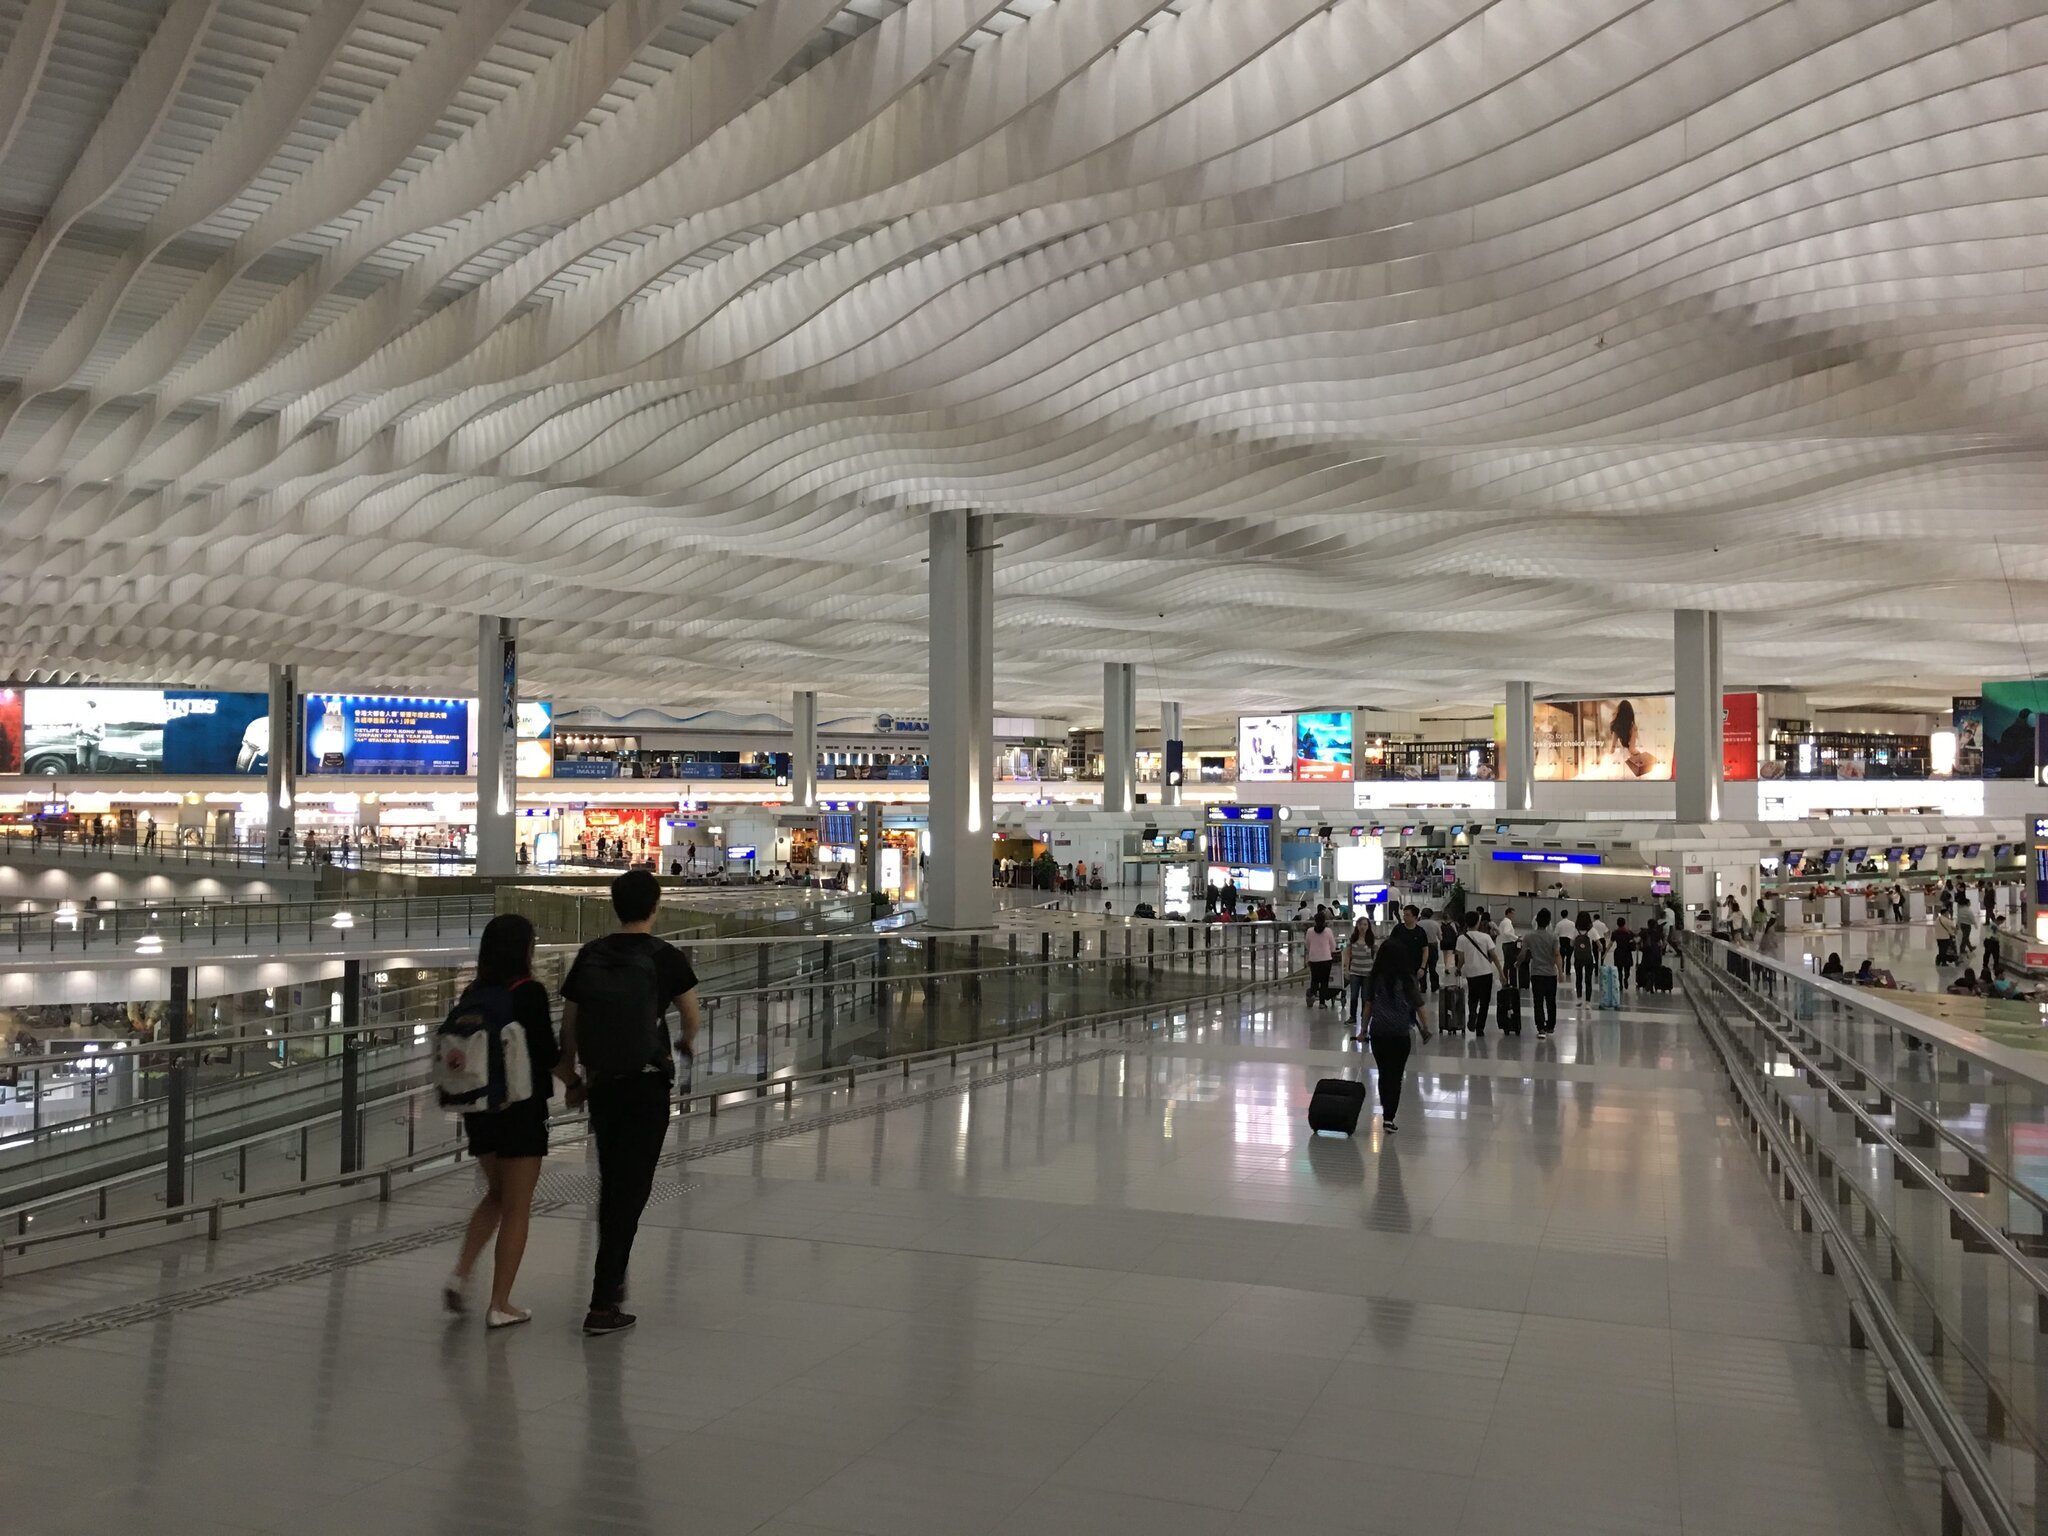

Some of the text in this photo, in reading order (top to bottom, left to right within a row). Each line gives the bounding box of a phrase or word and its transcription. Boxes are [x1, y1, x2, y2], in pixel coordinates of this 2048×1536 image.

[1586, 740, 1605, 748] today
[777, 776, 787, 786] N
[1170, 772, 1180, 785] P
